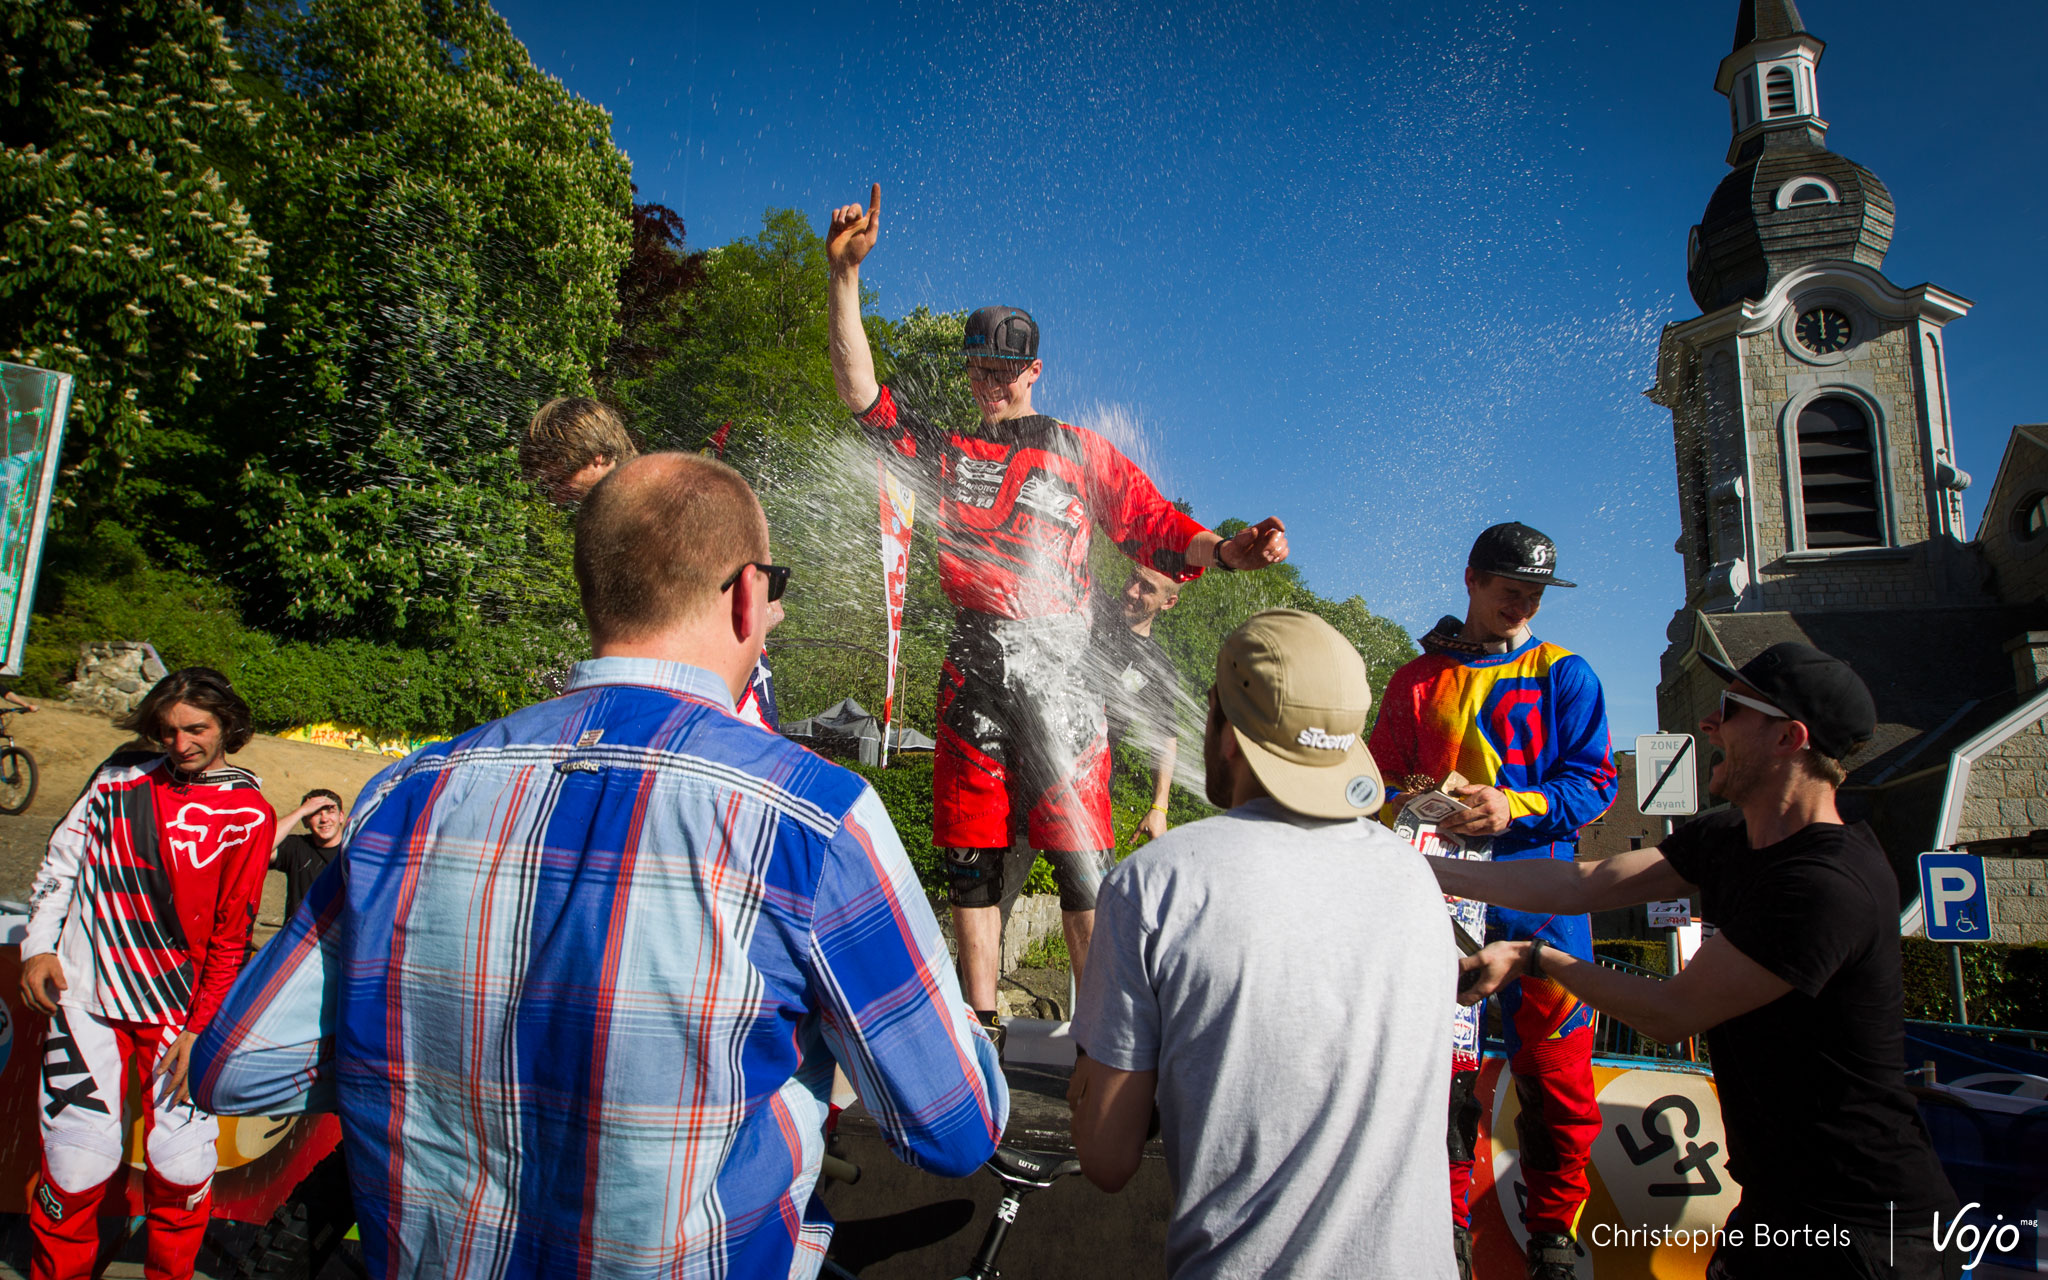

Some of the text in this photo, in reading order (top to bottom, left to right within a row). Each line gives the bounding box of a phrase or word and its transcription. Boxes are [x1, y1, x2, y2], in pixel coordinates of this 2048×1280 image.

[1515, 566, 1553, 575] SCOTT
[1650, 741, 1680, 750] ZONE
[1649, 800, 1686, 810] Payant
[1929, 867, 1977, 927] P
[1615, 1094, 1722, 1197] 45
[1018, 1159, 1040, 1171] WTB
